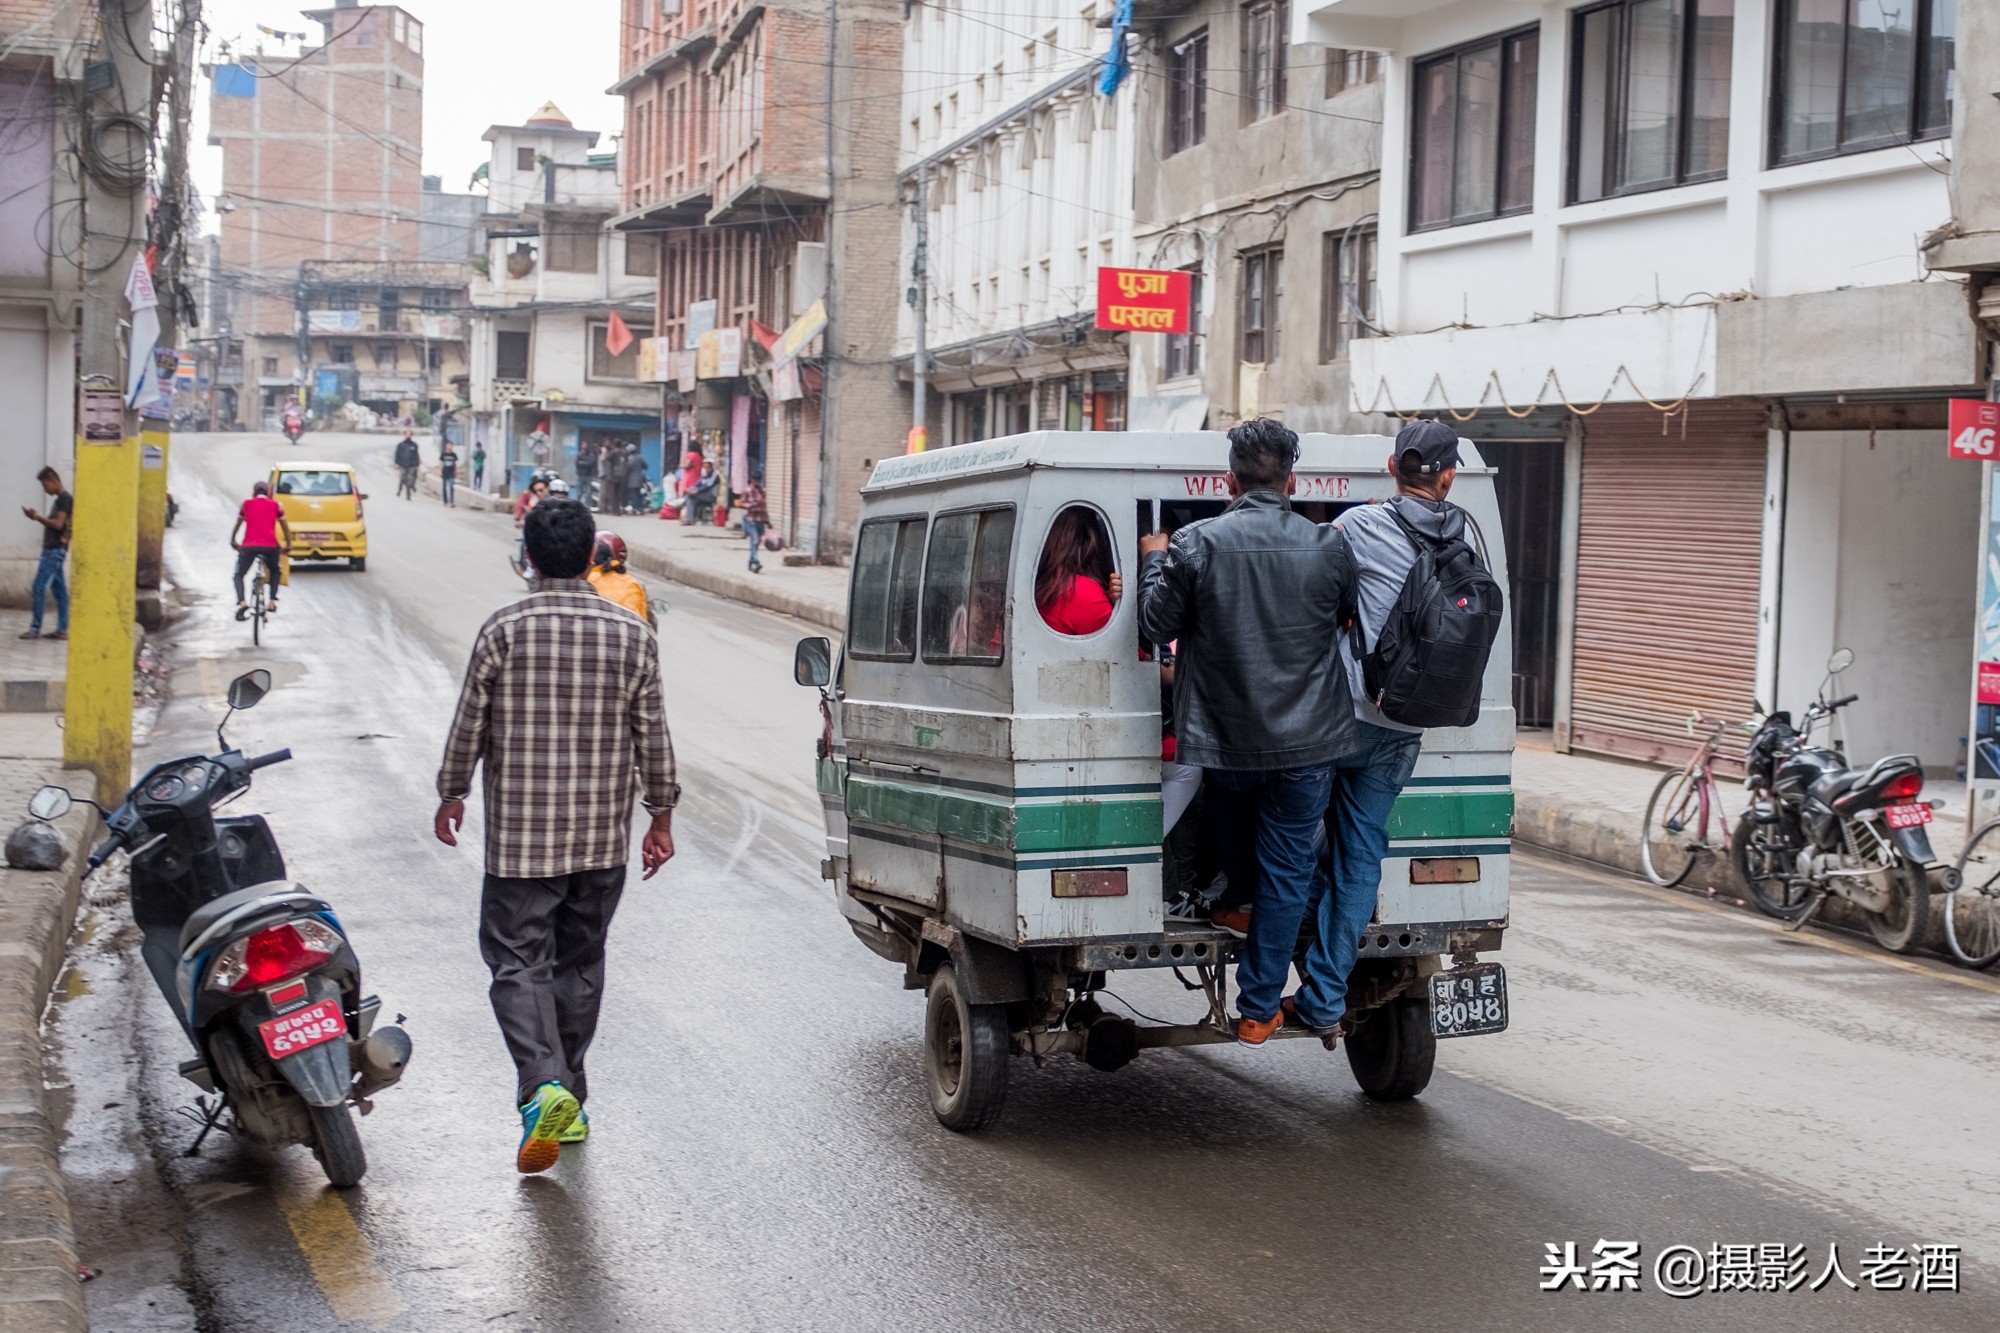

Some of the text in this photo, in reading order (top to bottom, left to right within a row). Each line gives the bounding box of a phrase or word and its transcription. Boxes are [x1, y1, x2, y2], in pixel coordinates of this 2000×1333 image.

[1117, 272, 1170, 298] पुजा
[1108, 305, 1176, 328] पसल
[1954, 426, 1996, 455] 4G
[1460, 978, 1474, 997] १
[1436, 998, 1501, 1027] ४०५४
[273, 1018, 340, 1050] ६१५२
